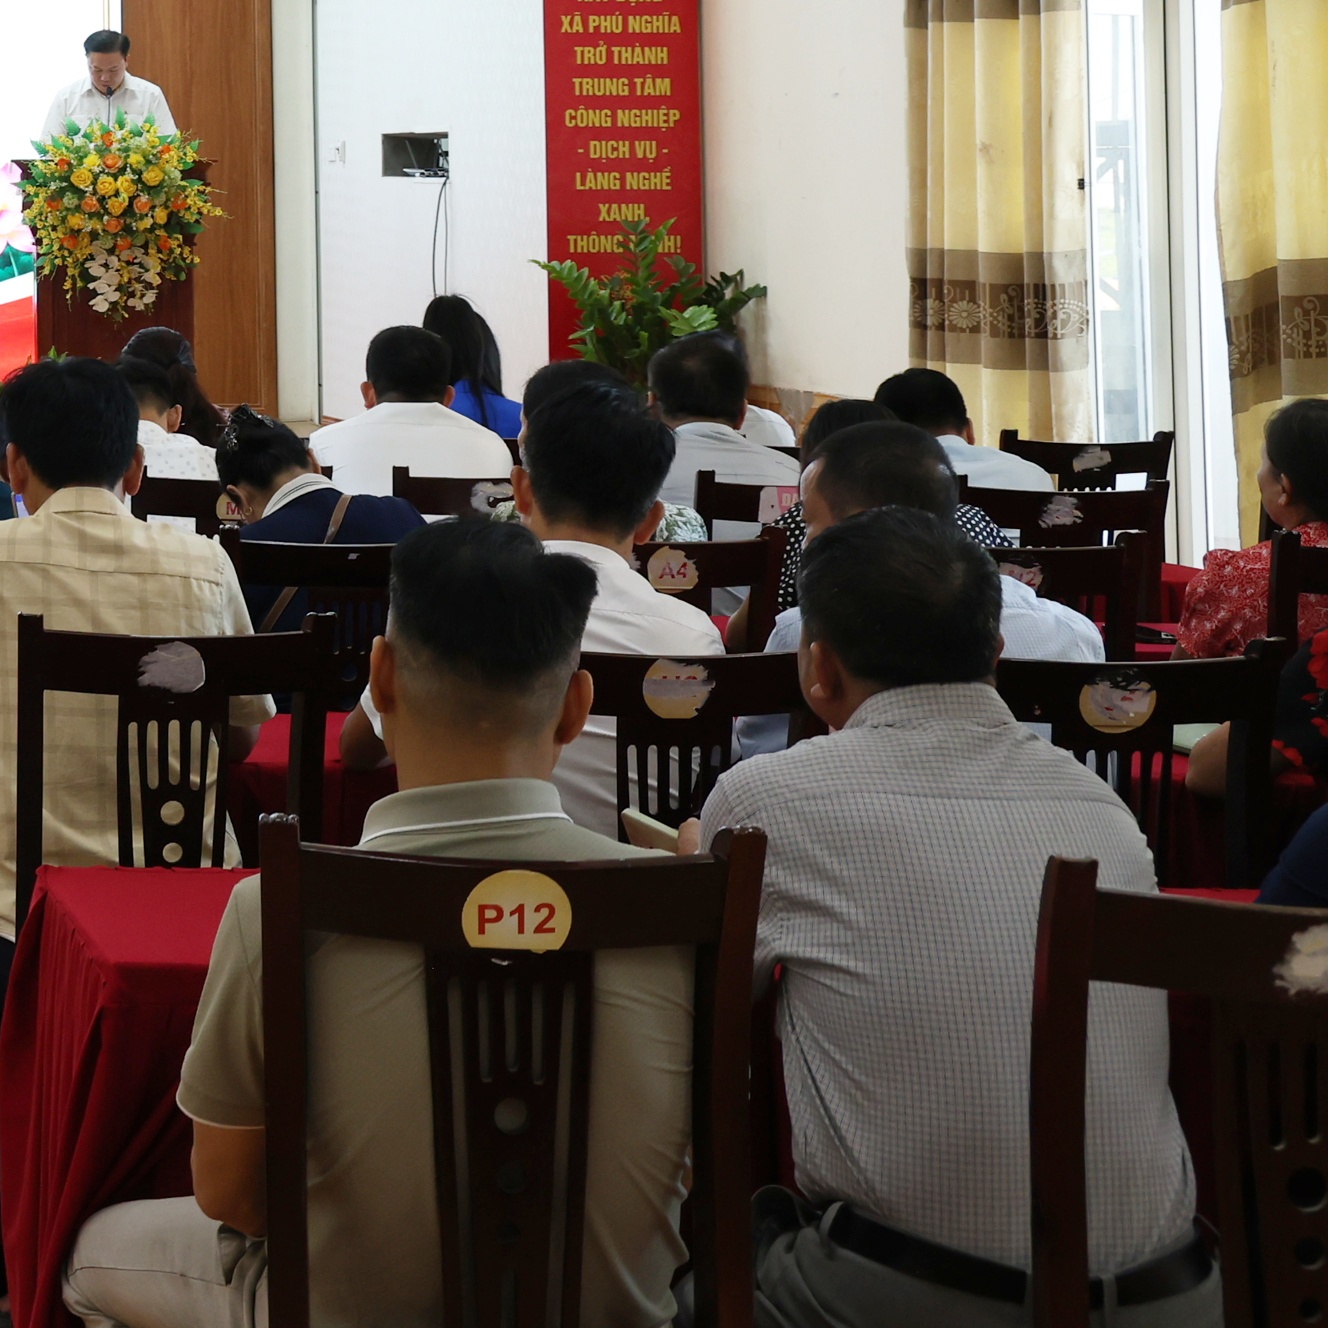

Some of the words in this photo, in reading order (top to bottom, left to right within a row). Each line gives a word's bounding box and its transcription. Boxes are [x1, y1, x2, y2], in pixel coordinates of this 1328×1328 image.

[561, 12, 583, 32] XÃ
[589, 12, 622, 33] PHÚ
[628, 12, 680, 33] NGHĨA
[575, 41, 607, 64] TRỞ
[612, 43, 668, 64] THÀNH
[573, 78, 629, 95] TRUNG
[634, 75, 670, 95] TÂM
[566, 106, 611, 127] CÔNG
[617, 106, 680, 131] NGHIỆP
[590, 141, 629, 162] DỊCH
[635, 141, 656, 162] VỤ
[576, 168, 620, 189] LÀNG
[599, 204, 649, 223] XANH,
[568, 232, 625, 253] THÔNG
[478, 902, 556, 935] P12
